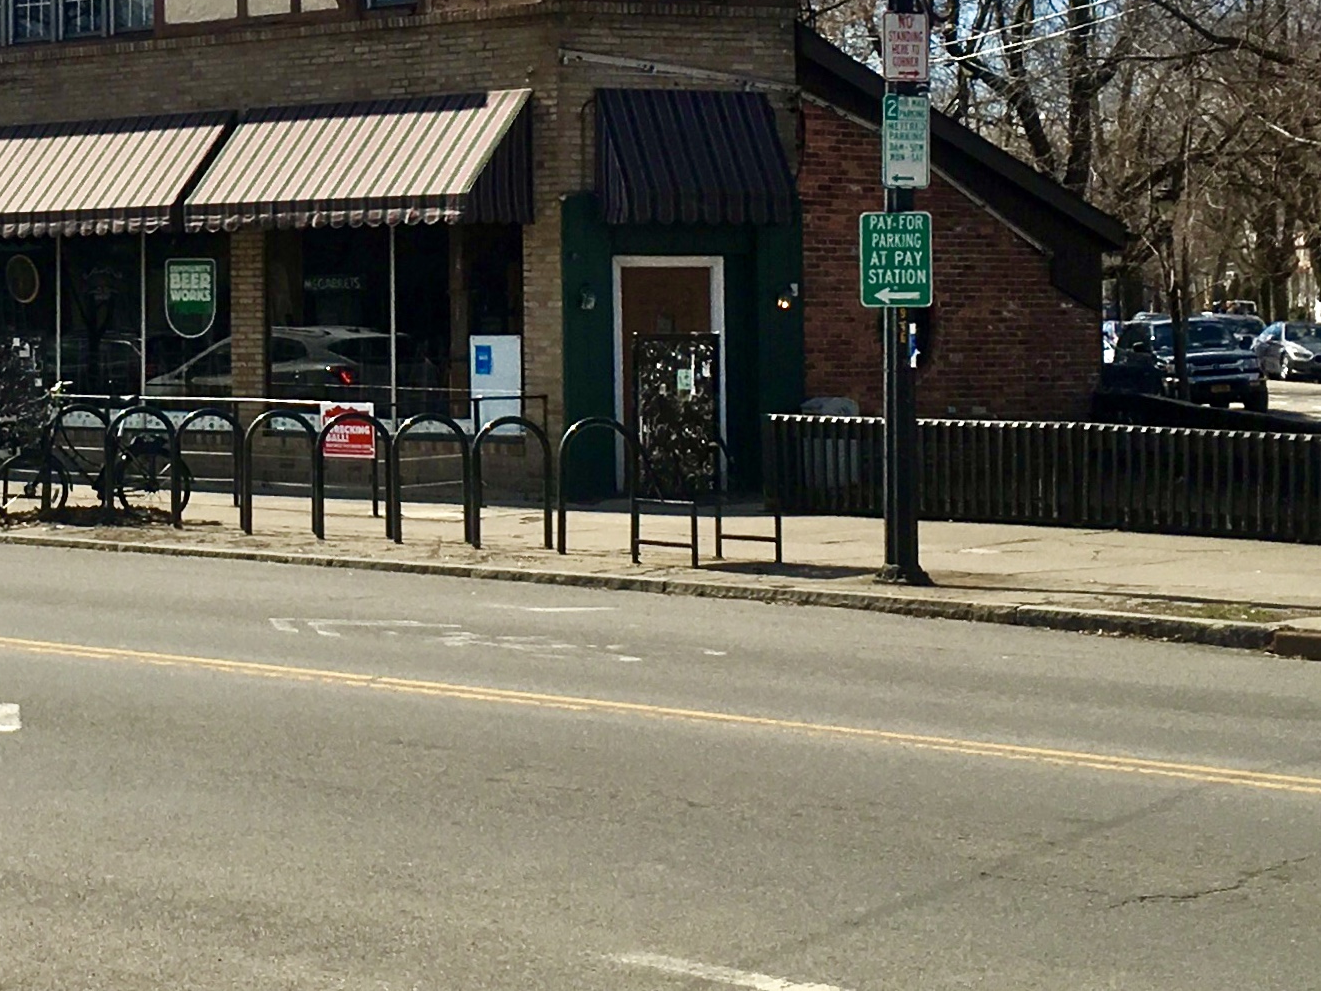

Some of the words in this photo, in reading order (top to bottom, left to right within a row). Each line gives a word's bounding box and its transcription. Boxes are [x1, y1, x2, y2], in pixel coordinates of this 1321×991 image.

[898, 15, 913, 28] NO
[888, 31, 923, 42] STANDING
[887, 99, 897, 117] 2
[889, 131, 924, 140] PARKING
[870, 215, 893, 230] PAY
[899, 215, 923, 230] FOR
[872, 233, 921, 248] PARKING
[870, 251, 887, 266] AT
[894, 251, 922, 266] PAY
[169, 273, 211, 289] BEER
[868, 269, 926, 284] STATION
[170, 290, 212, 301] WORKS
